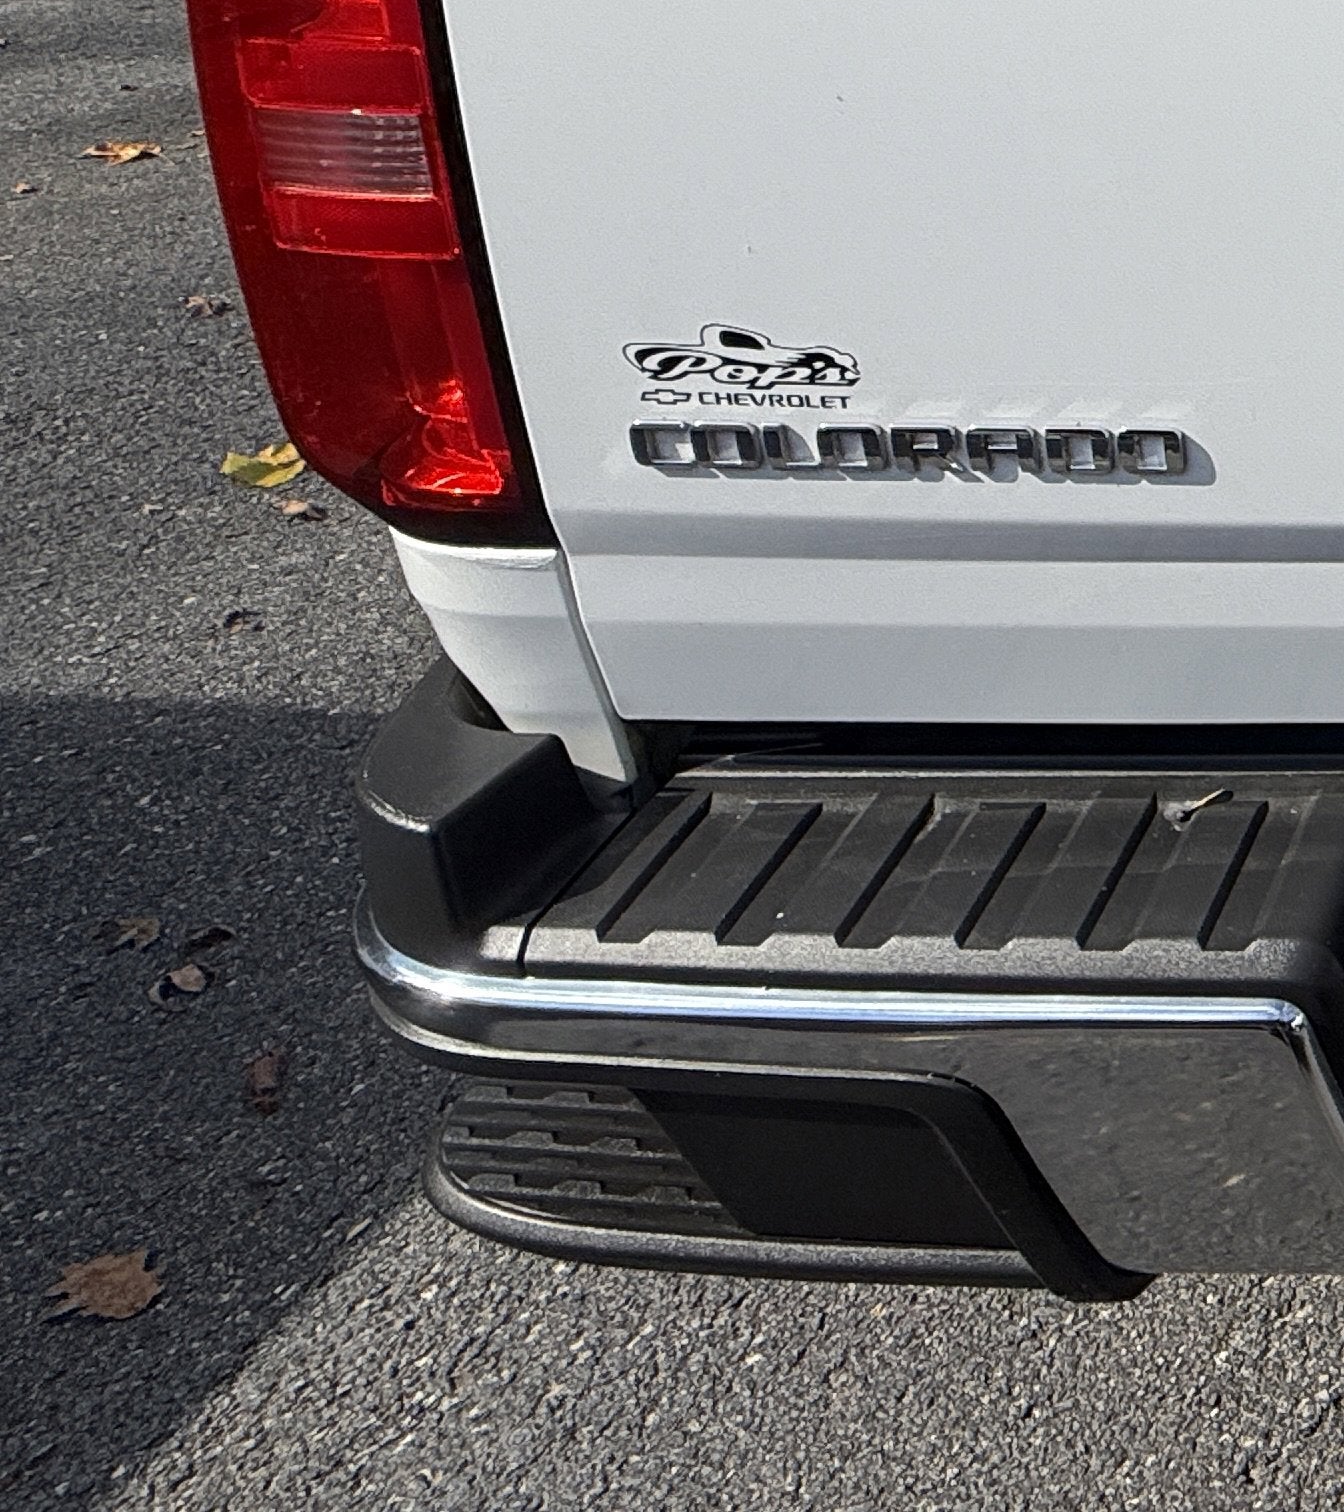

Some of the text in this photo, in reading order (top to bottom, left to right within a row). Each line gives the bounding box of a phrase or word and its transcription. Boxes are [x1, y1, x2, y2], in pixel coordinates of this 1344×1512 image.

[642, 350, 861, 390] Pop's
[698, 391, 851, 409] CHEVROLET
[630, 419, 1187, 475] COLORADO
